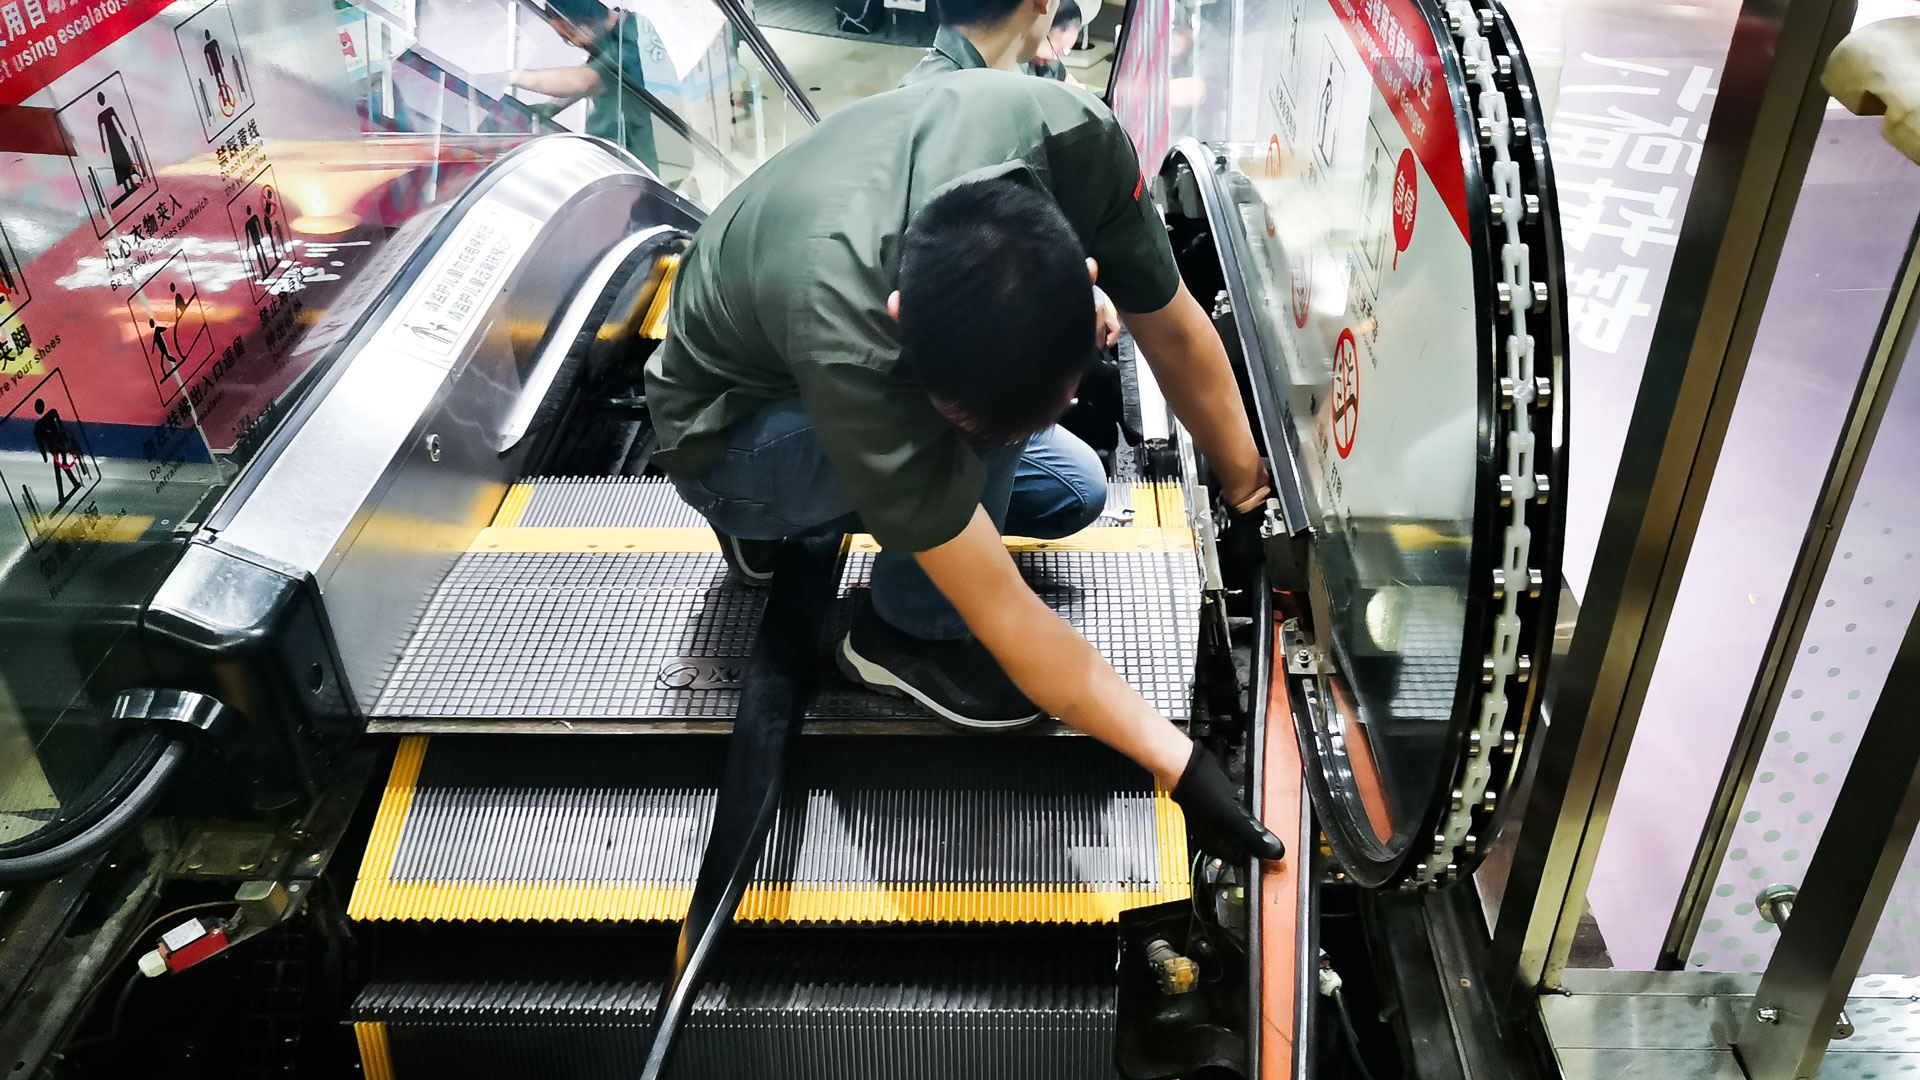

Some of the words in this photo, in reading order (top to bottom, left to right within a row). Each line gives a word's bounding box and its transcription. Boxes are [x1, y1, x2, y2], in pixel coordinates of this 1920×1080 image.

[11, 36, 58, 72] using
[105, 194, 183, 272] 小心衣物夹入
[177, 196, 208, 231] sandwich
[10, 360, 33, 388] your
[33, 334, 62, 364] shoes
